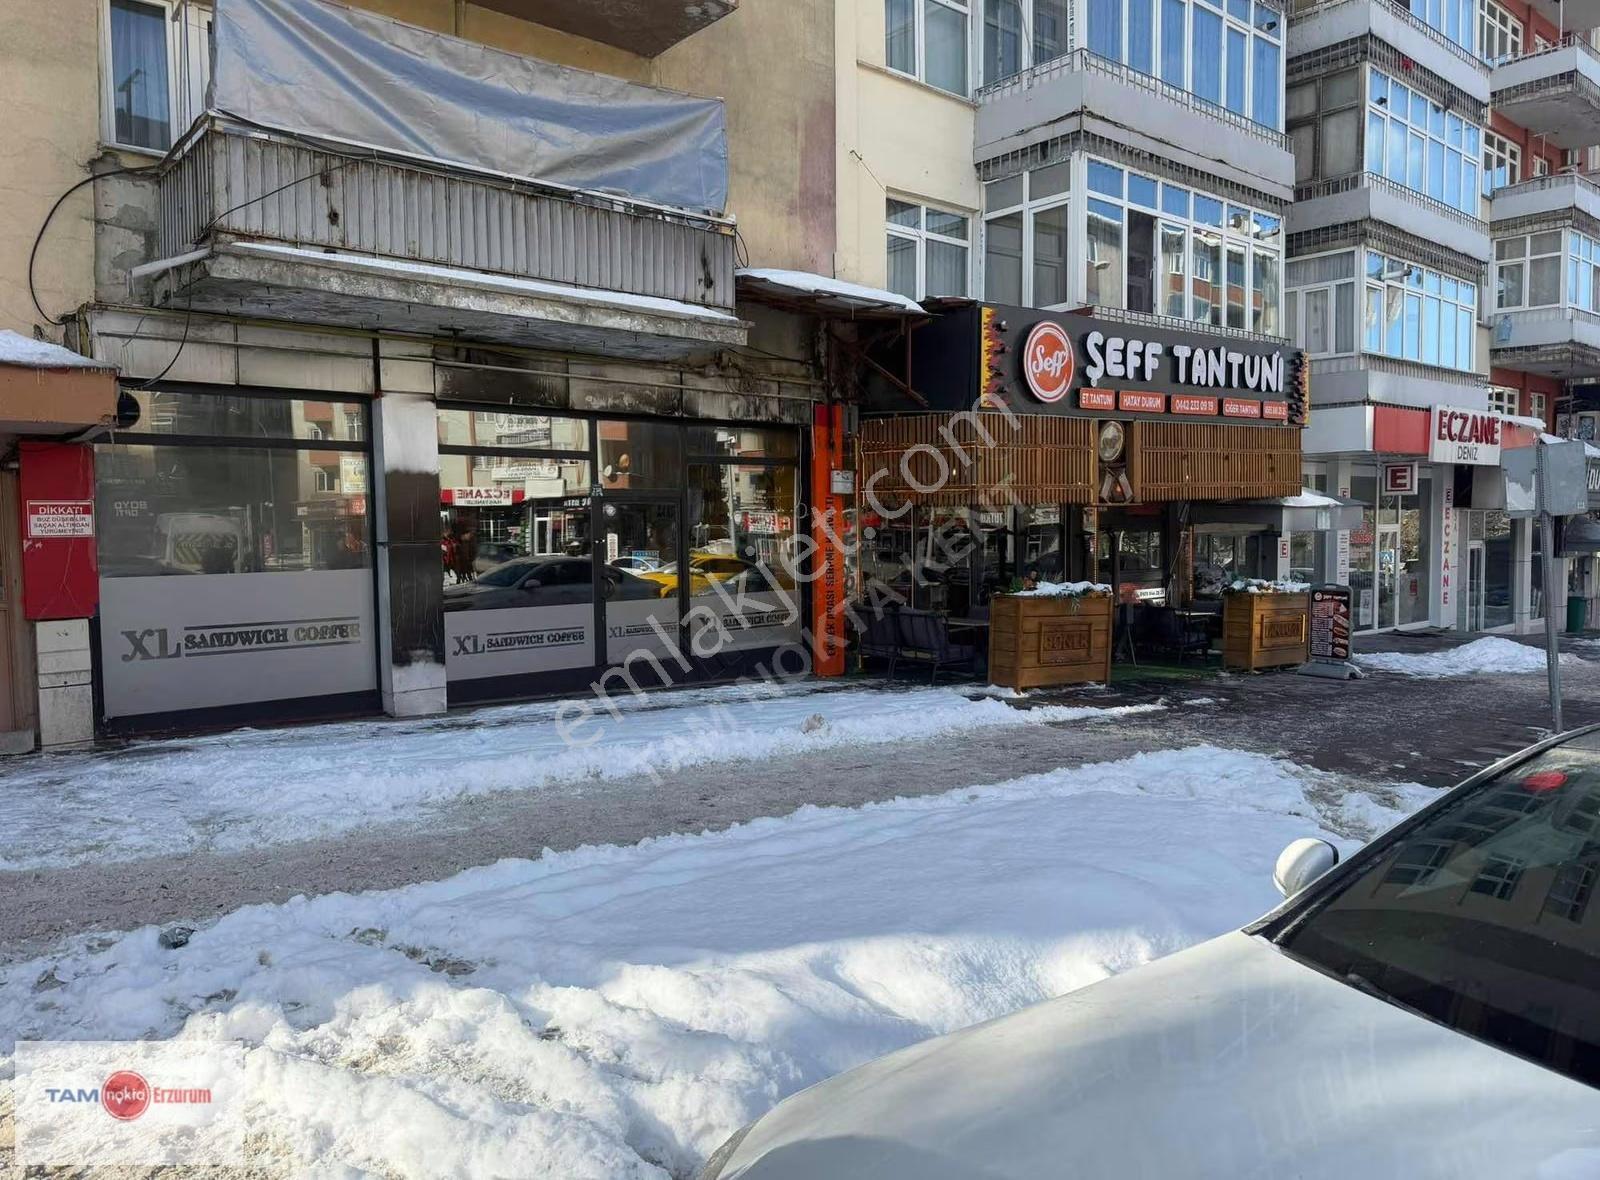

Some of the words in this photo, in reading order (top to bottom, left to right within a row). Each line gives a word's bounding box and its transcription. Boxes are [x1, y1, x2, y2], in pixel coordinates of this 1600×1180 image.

[1086, 331, 1163, 387] ŞEFF
[1173, 346, 1284, 392] TANTUNİ
[1123, 395, 1140, 407] HATAY
[1438, 409, 1500, 445] ECZANE
[1457, 443, 1477, 461] DENİZ
[1391, 468, 1407, 488] E
[39, 505, 83, 514] DİKKAT!
[1443, 507, 1451, 605] ECZANE
[121, 628, 181, 662] XL
[184, 628, 288, 650] SANDWICH
[294, 623, 360, 642] COFFEE
[453, 635, 485, 656] XL
[487, 634, 544, 648] SANDWICH
[547, 631, 585, 643] COFFEE
